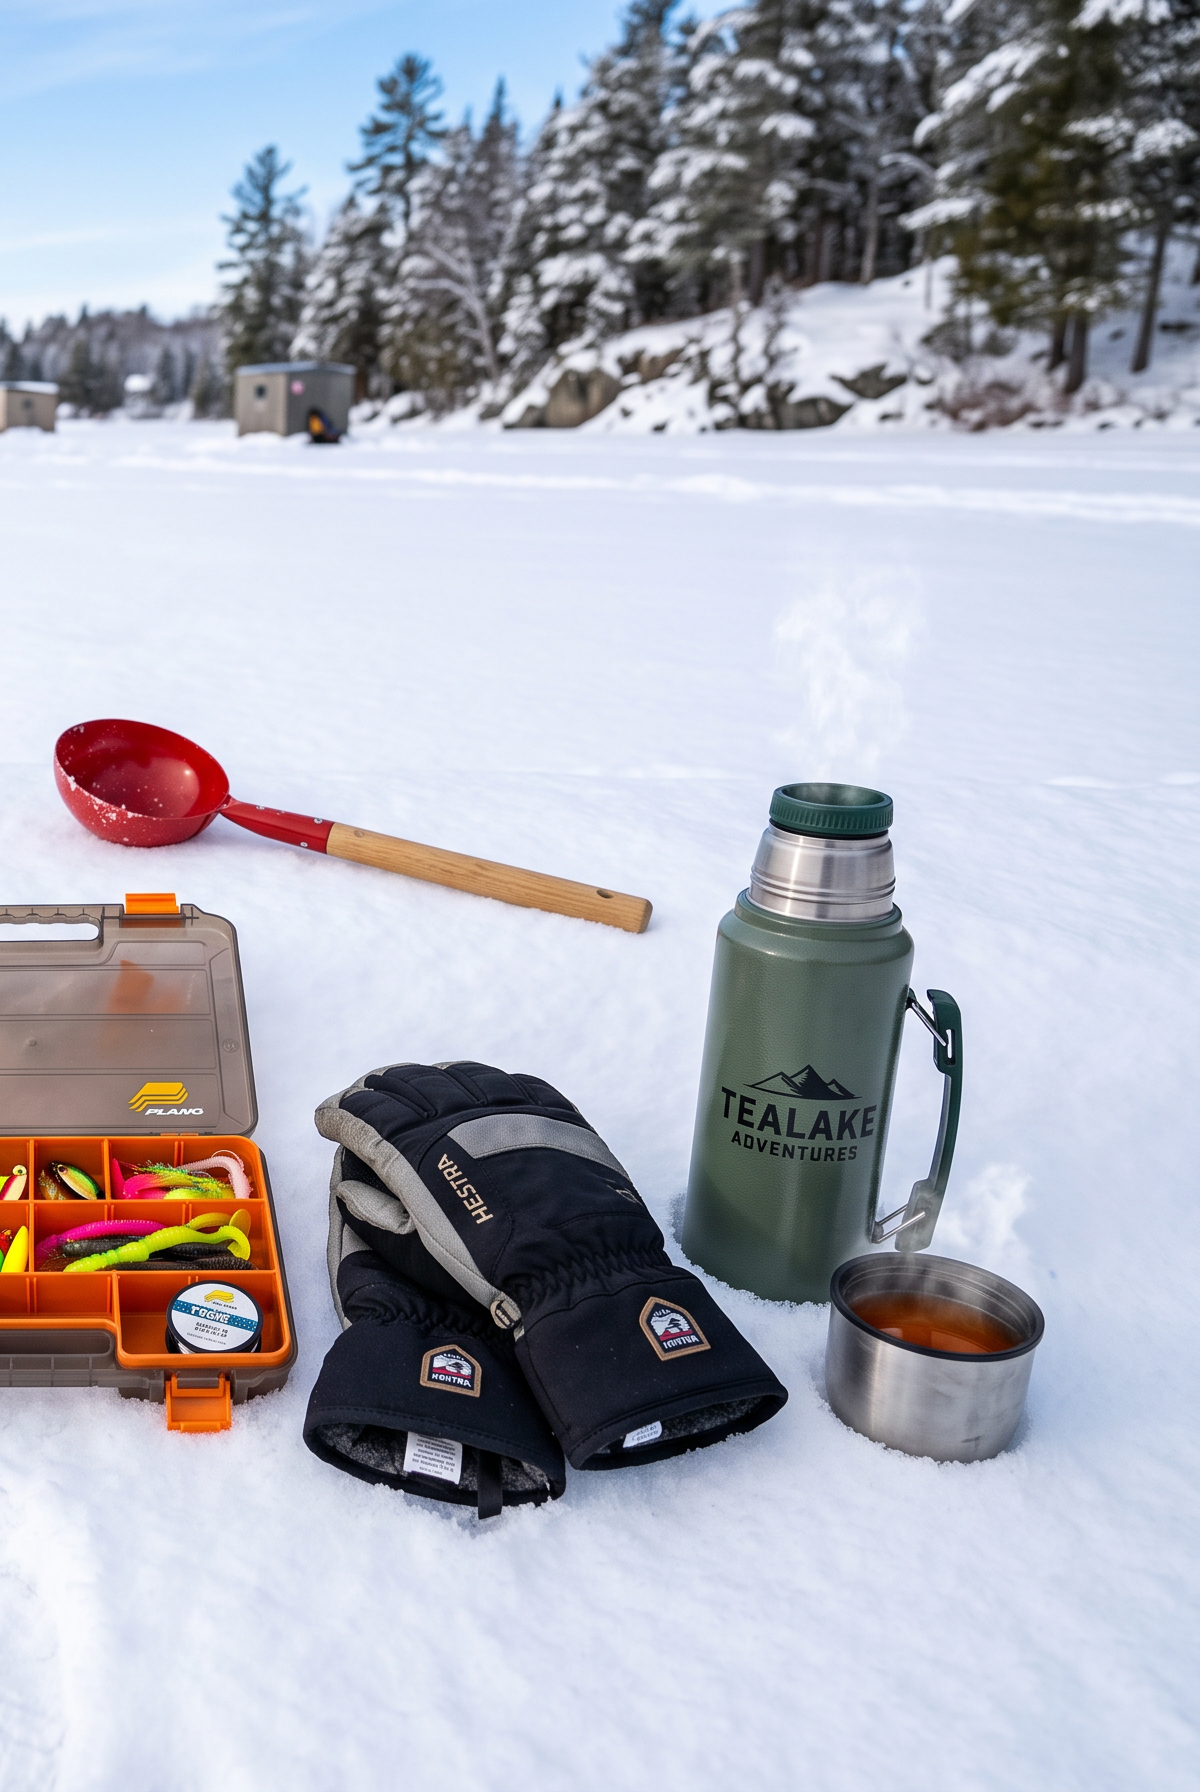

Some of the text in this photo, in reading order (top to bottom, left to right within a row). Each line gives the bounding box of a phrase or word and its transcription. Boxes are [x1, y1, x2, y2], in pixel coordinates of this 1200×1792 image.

[721, 1086, 878, 1141] TEALAKE
[730, 1130, 859, 1162] ADVENTURES
[437, 1153, 494, 1225] HESTRA
